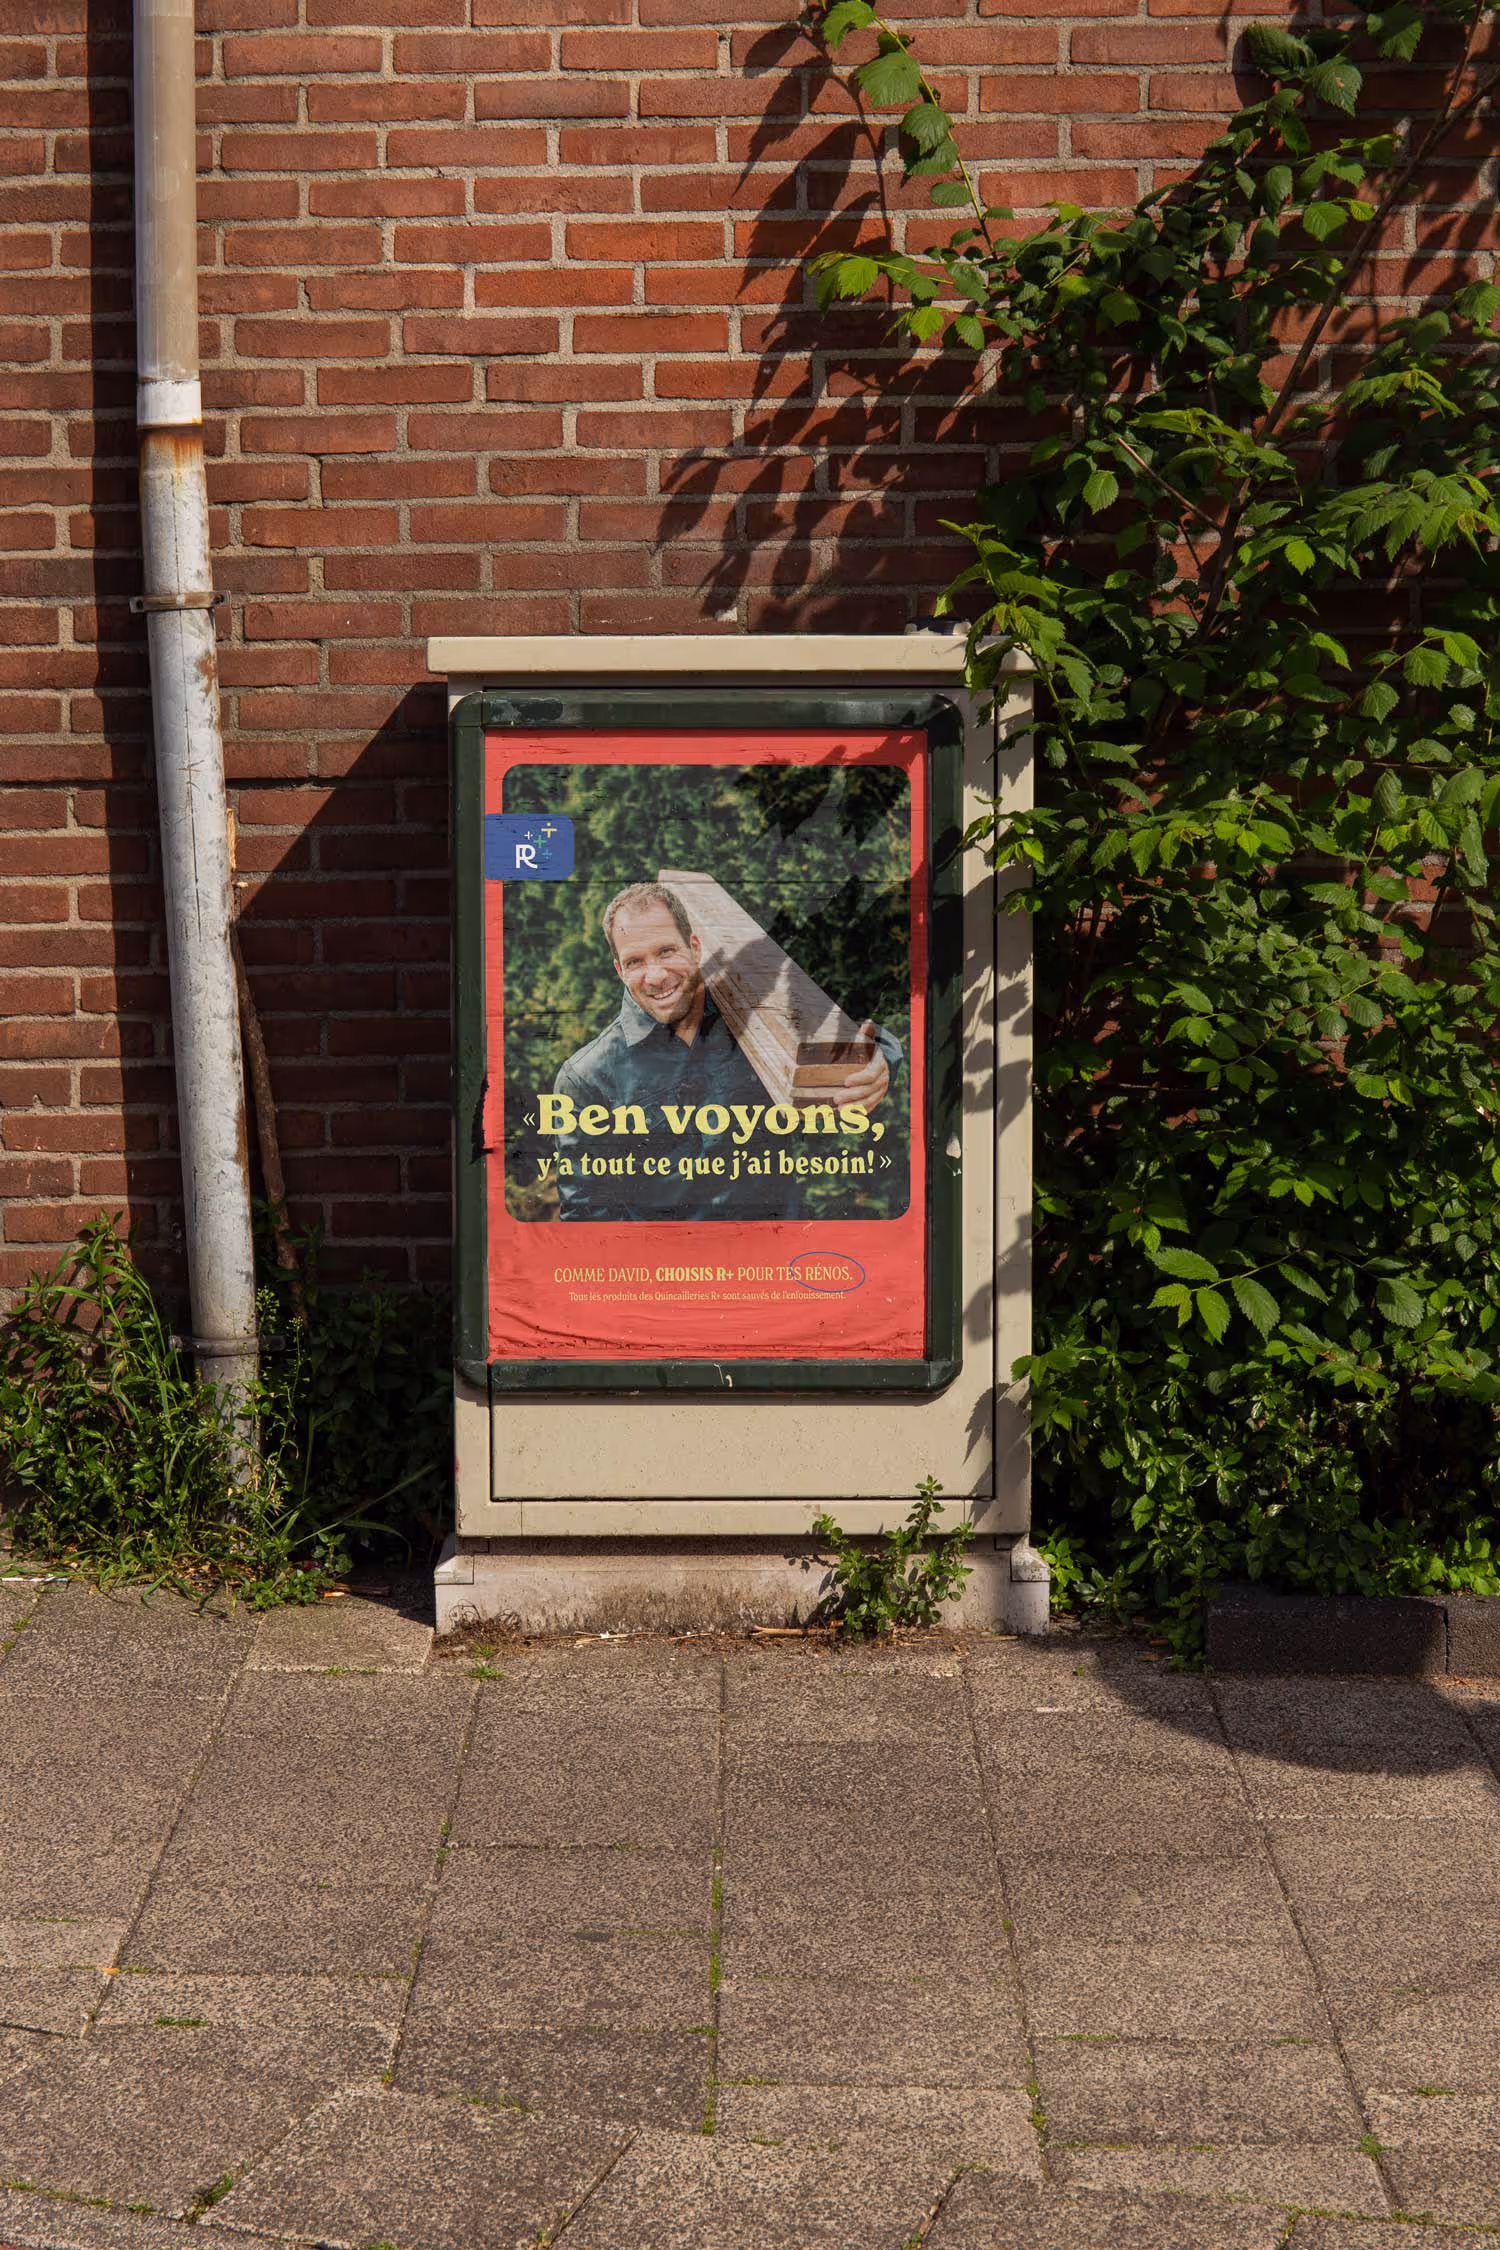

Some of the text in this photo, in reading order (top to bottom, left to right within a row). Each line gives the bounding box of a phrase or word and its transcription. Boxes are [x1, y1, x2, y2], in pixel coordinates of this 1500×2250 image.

[660, 1104, 885, 1145] voyons,
[537, 1151, 574, 1181] y’a
[580, 1152, 637, 1176] tout
[643, 1156, 671, 1176] ce
[678, 1156, 726, 1181] que
[729, 1150, 772, 1181] j’ai
[554, 1262, 853, 1284] COMME DAVID, CHOISIS R+ POUR TES RÉNOS.
[569, 1291, 587, 1301] Tous
[590, 1291, 601, 1300] les
[603, 1291, 637, 1303] produits
[639, 1291, 653, 1300] des
[655, 1290, 709, 1301] Quincailleries
[711, 1290, 720, 1300] R+
[722, 1291, 740, 1300] sont
[742, 1290, 769, 1300] sauvés
[771, 1290, 781, 1300] de
